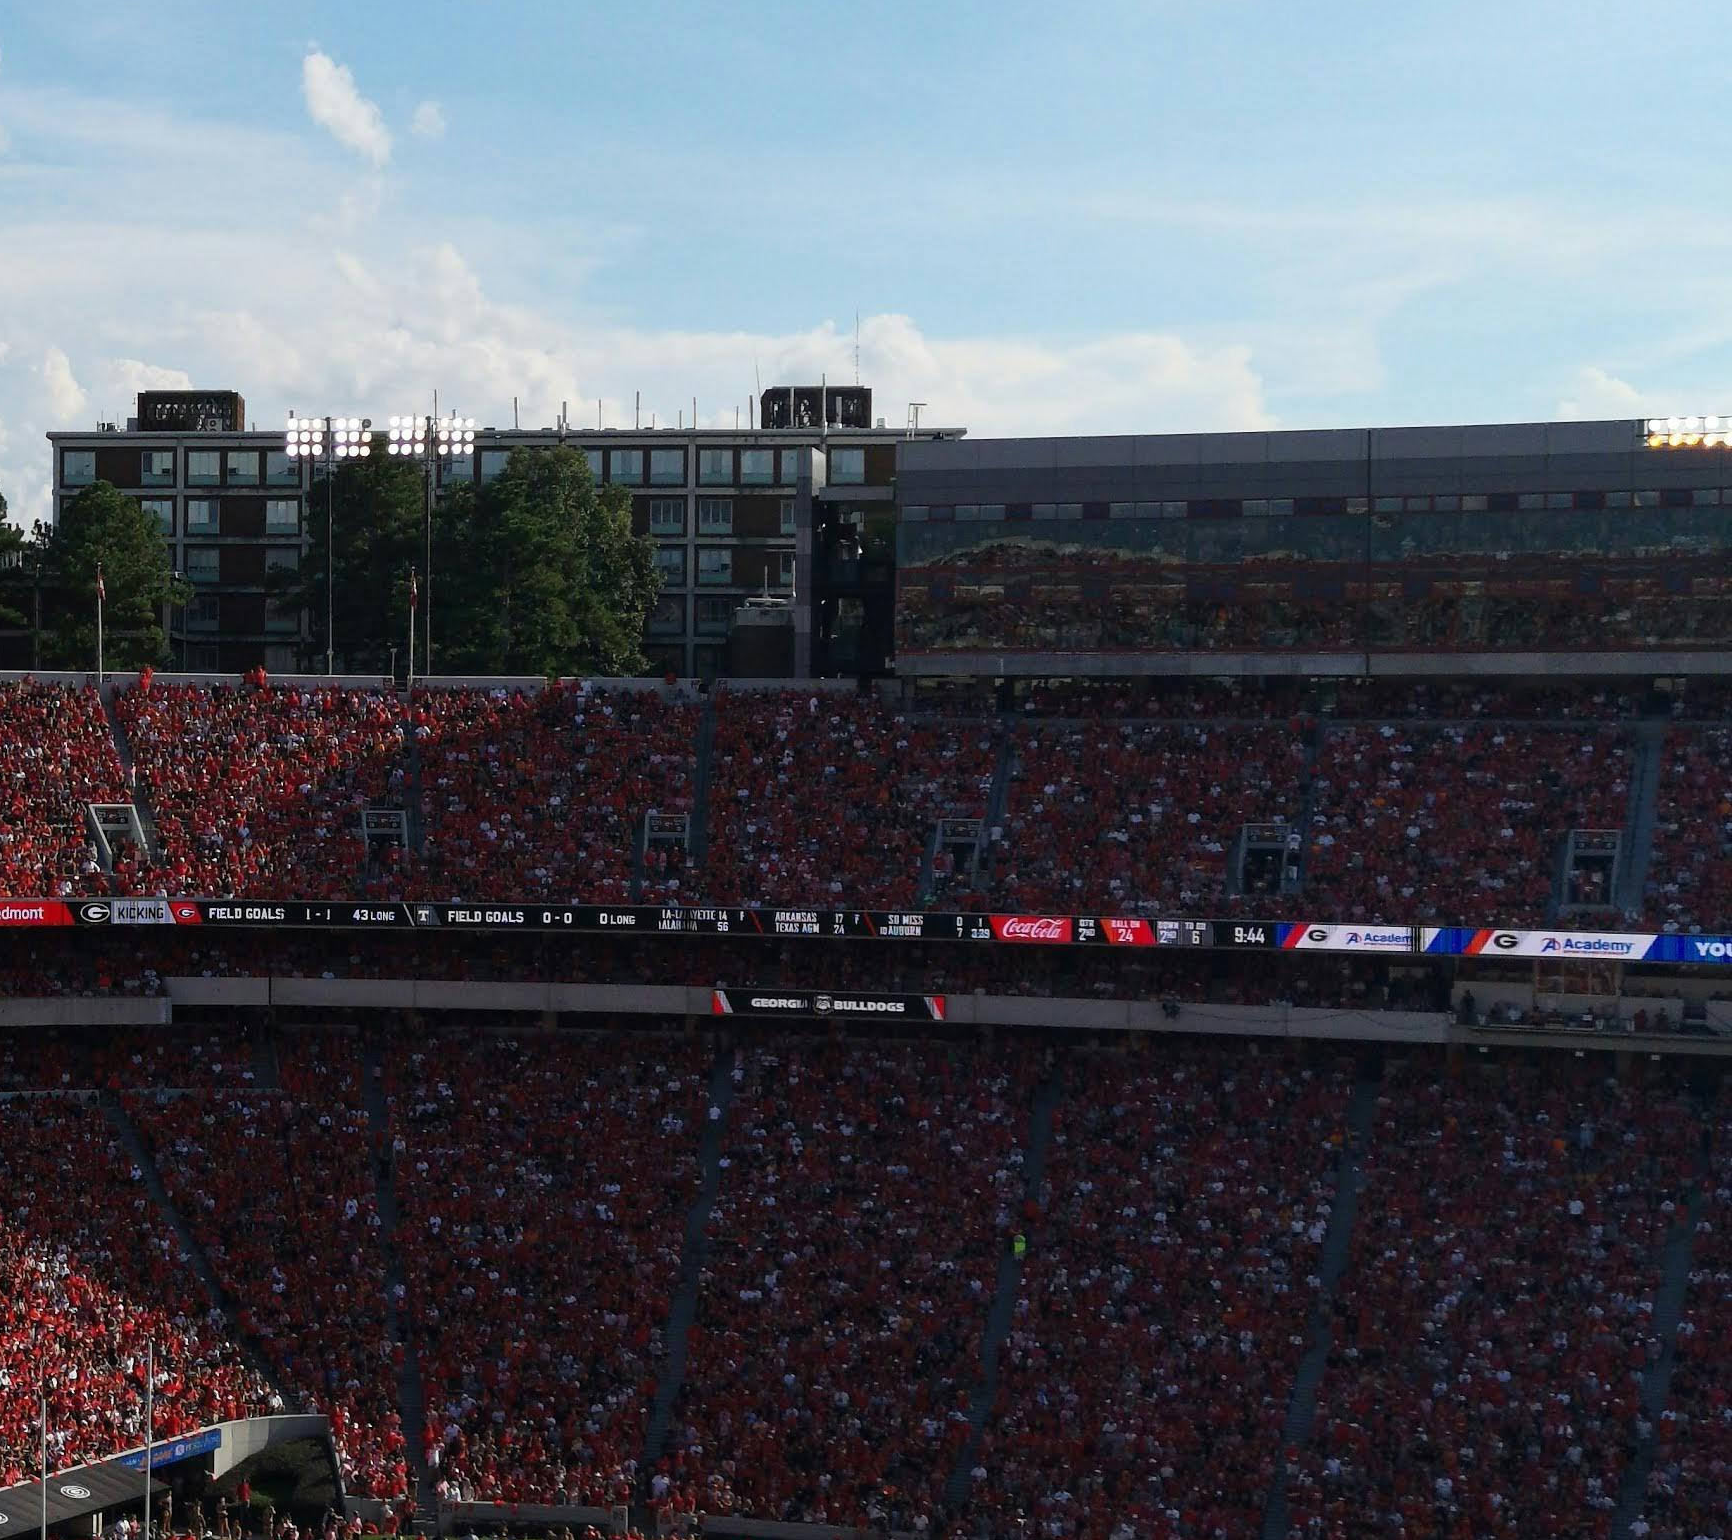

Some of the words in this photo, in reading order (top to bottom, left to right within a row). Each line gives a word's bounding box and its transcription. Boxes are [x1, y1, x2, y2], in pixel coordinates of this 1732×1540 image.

[118, 907, 164, 919] KICKING
[209, 908, 242, 920] FIELD
[246, 908, 285, 920] GOALS
[353, 909, 368, 921] 43
[370, 911, 395, 921] LONG
[448, 910, 482, 923] FIELD
[485, 911, 524, 923] GOALS
[542, 911, 552, 924] 0
[563, 912, 573, 924] 0
[599, 912, 608, 924] 0
[610, 914, 636, 925] LONG
[775, 912, 818, 923] ARKANSAS
[835, 914, 844, 924] 17
[888, 914, 900, 925] SO
[902, 915, 924, 926] MISS
[775, 922, 800, 933] TEXAS
[956, 928, 964, 938] 7
[1118, 928, 1134, 942] 24
[1191, 930, 1200, 944] 6
[1234, 927, 1266, 943] 9:44
[1308, 929, 1328, 942] G
[1494, 933, 1518, 949] G
[1563, 938, 1634, 954] Academy
[833, 1000, 905, 1012] BULLDOGS
